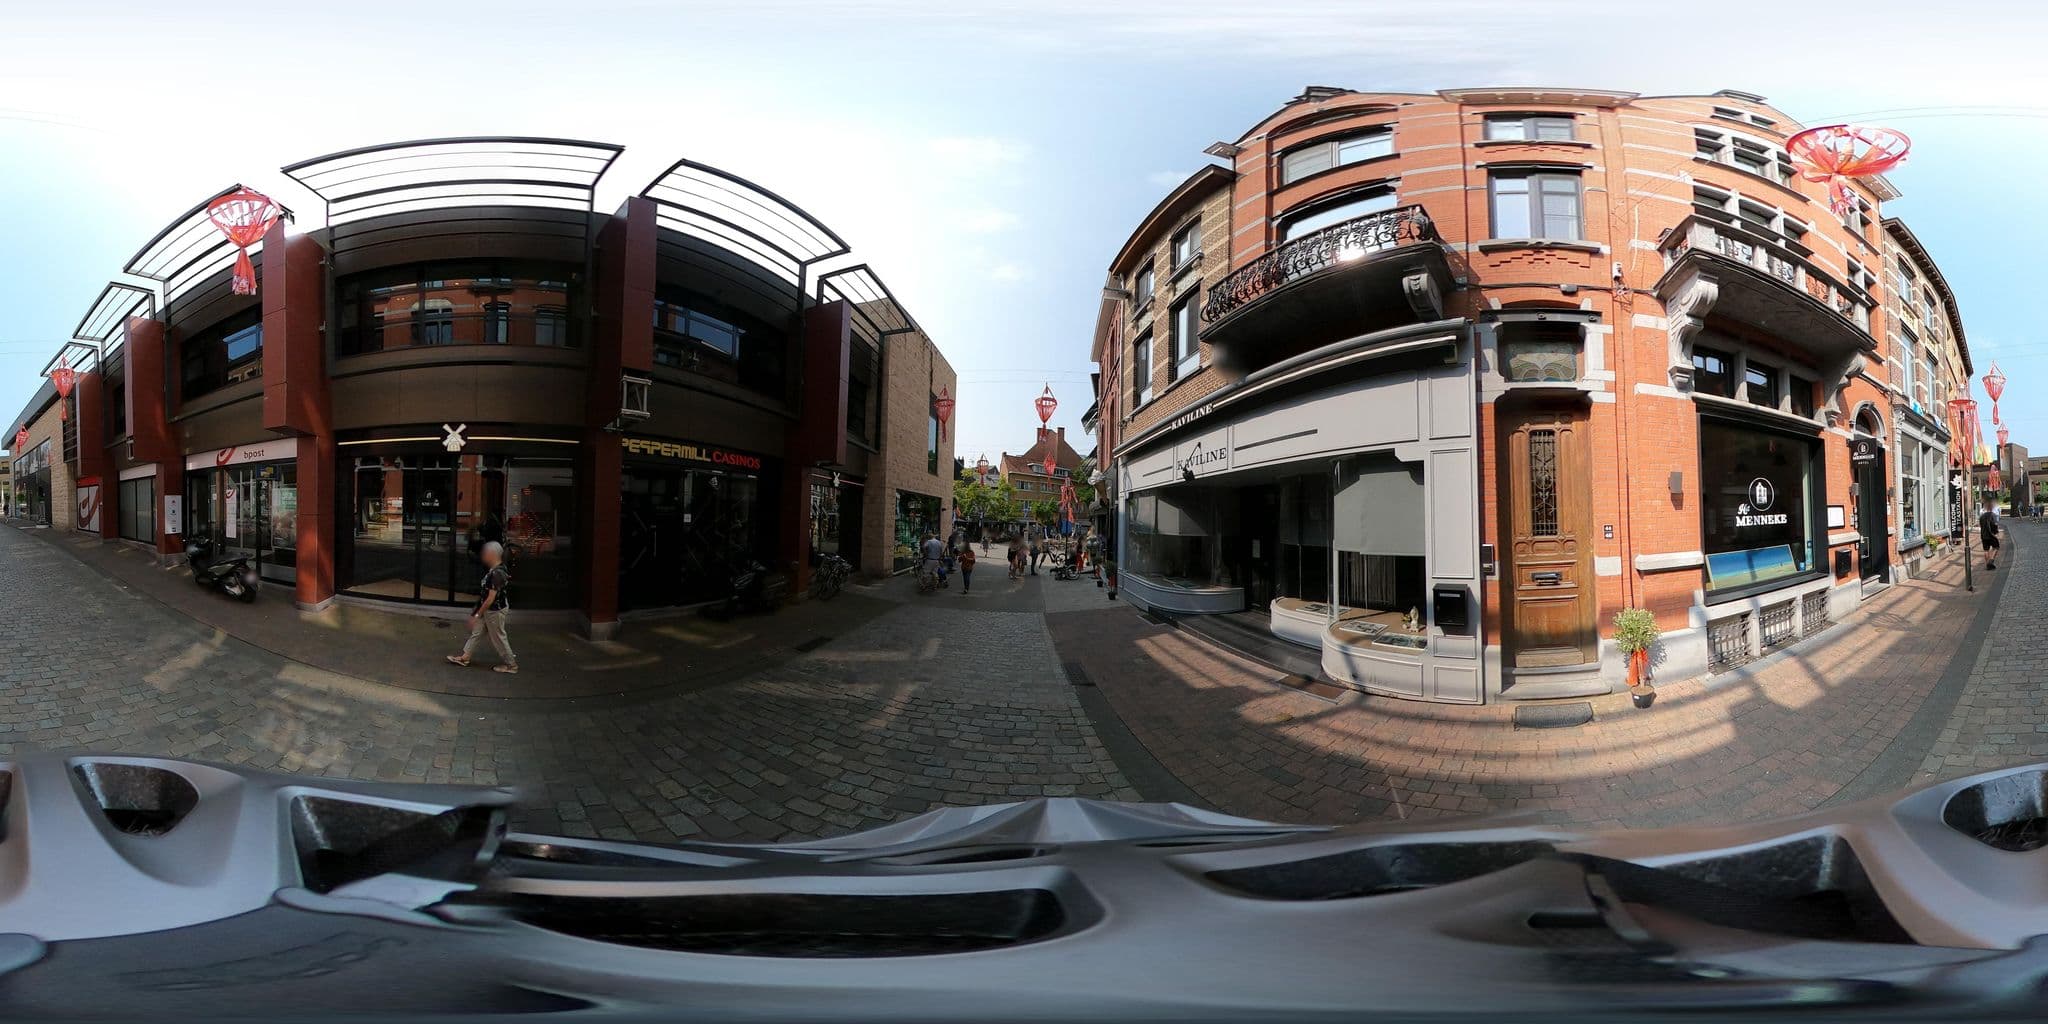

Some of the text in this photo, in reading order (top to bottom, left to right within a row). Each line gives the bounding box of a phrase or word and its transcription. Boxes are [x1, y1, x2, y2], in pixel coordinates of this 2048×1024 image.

[1171, 403, 1213, 430] KAVILINE
[243, 449, 265, 460] bpost
[712, 451, 760, 470] CASINOS
[1176, 447, 1227, 471] KAVILINE
[1735, 514, 1787, 527] MENNEKE
